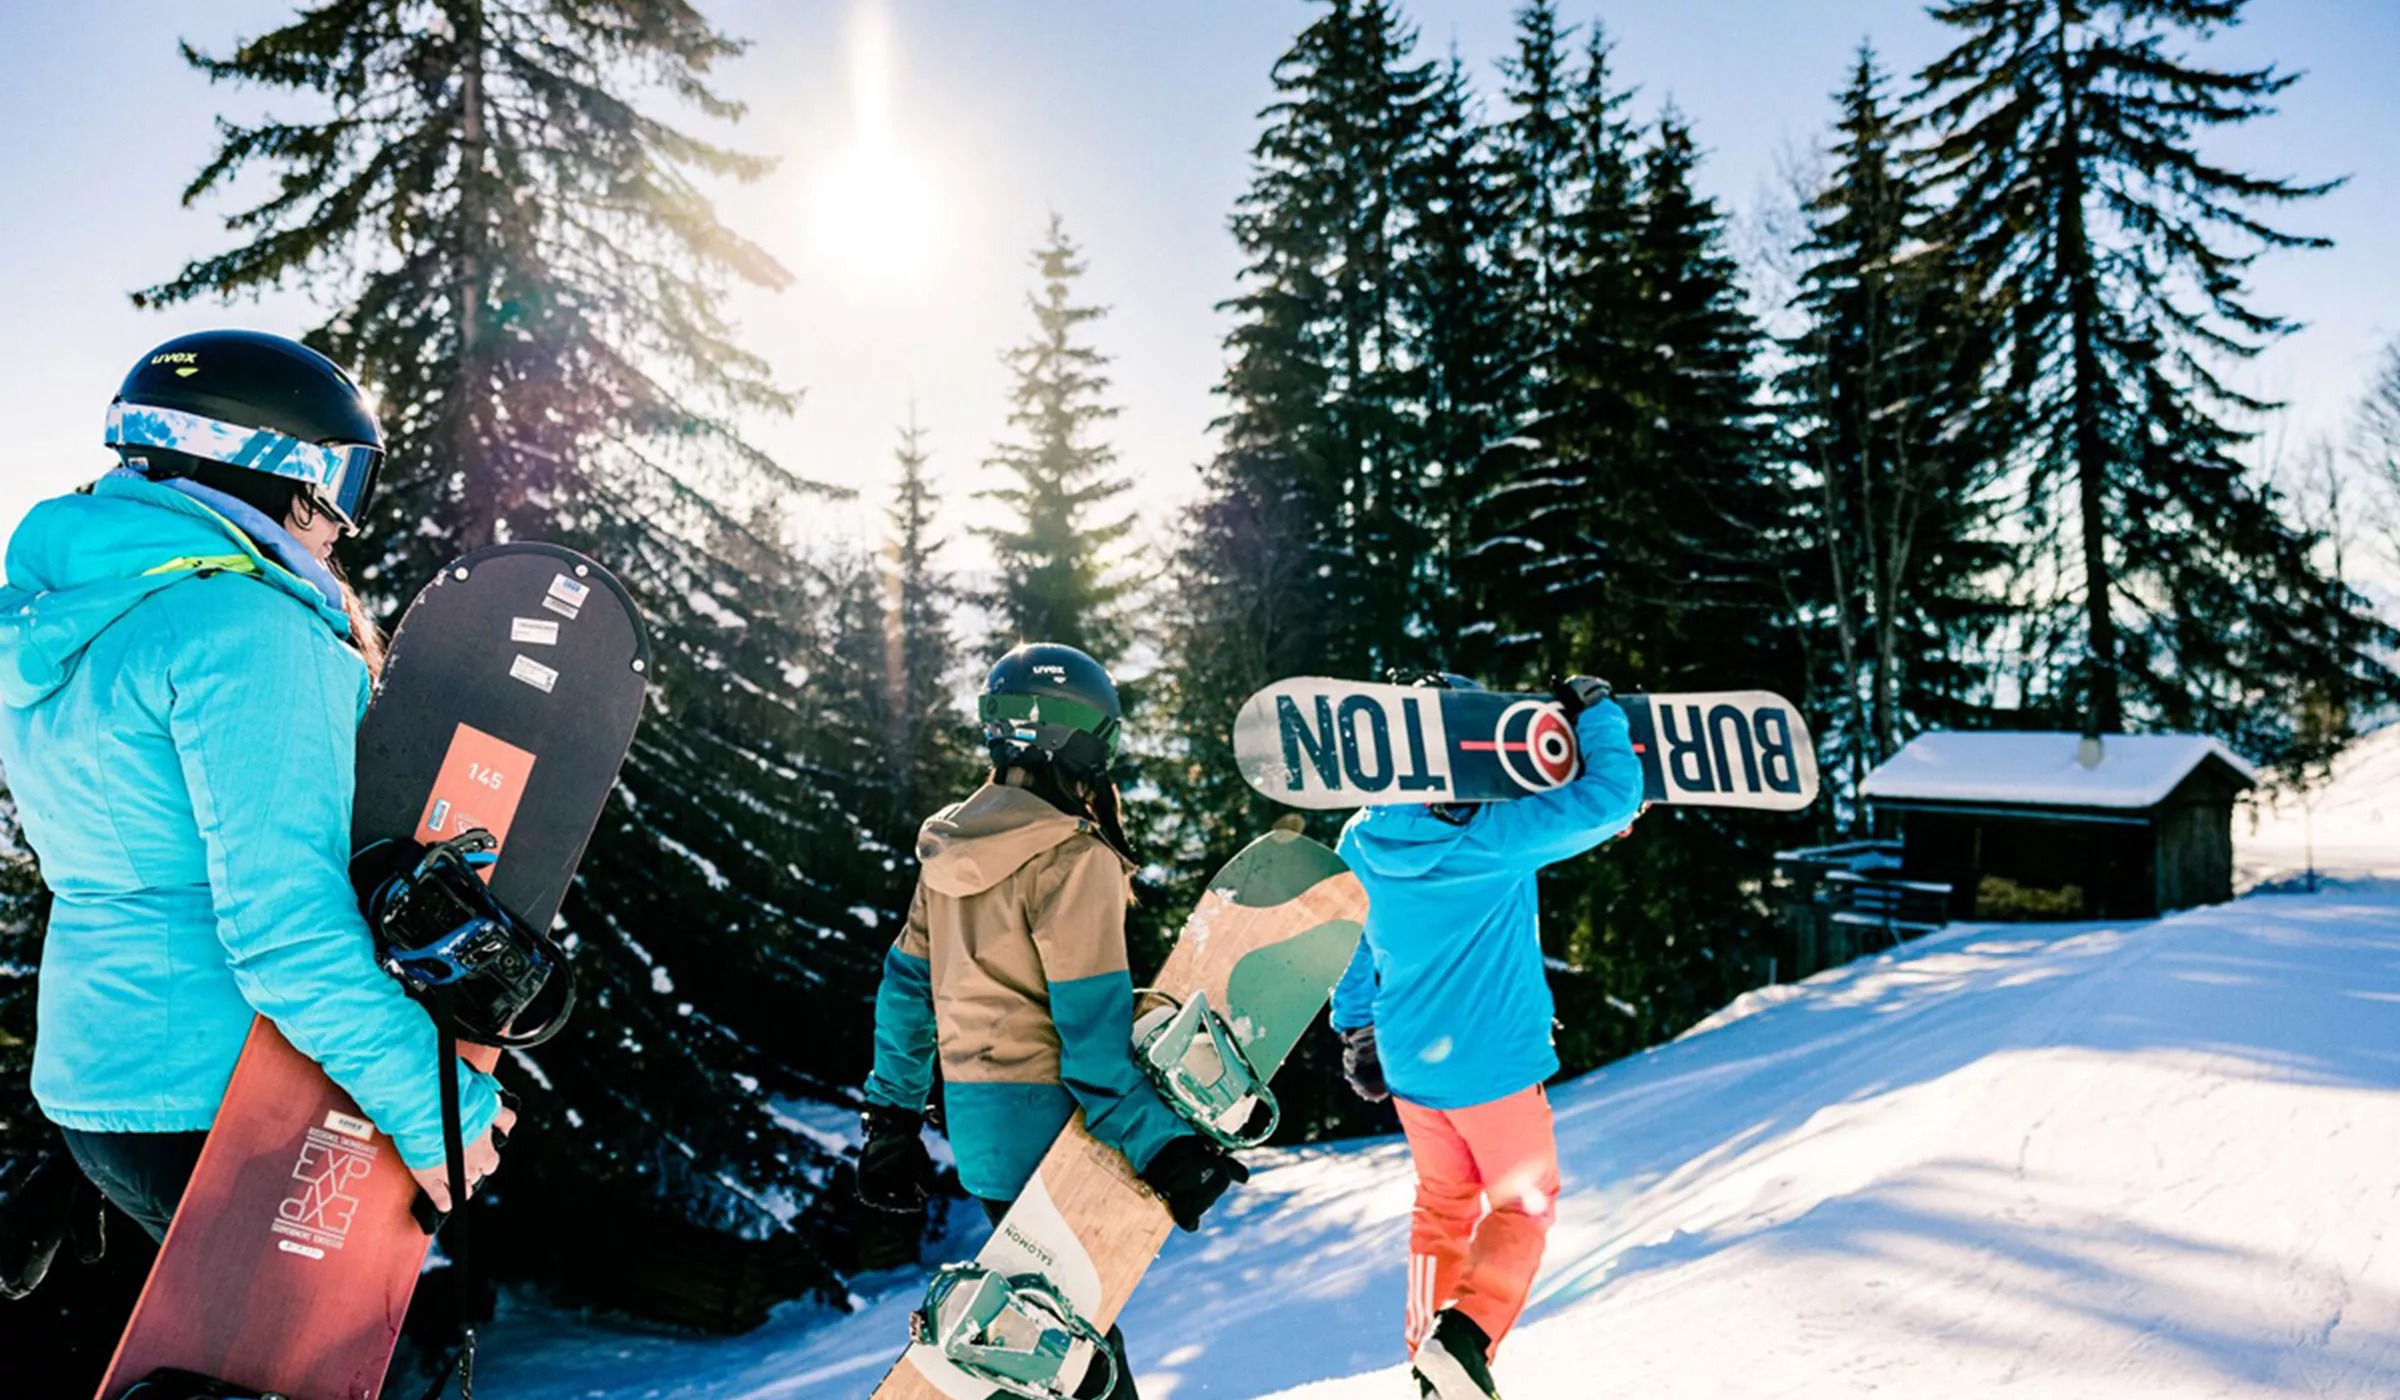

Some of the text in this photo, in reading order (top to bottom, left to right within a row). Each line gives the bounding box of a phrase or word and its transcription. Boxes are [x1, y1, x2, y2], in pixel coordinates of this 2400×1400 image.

[151, 352, 197, 365] uvex
[468, 762, 504, 790] 145
[292, 1141, 372, 1193] EXP
[1005, 1227, 1054, 1266] SALOMON
